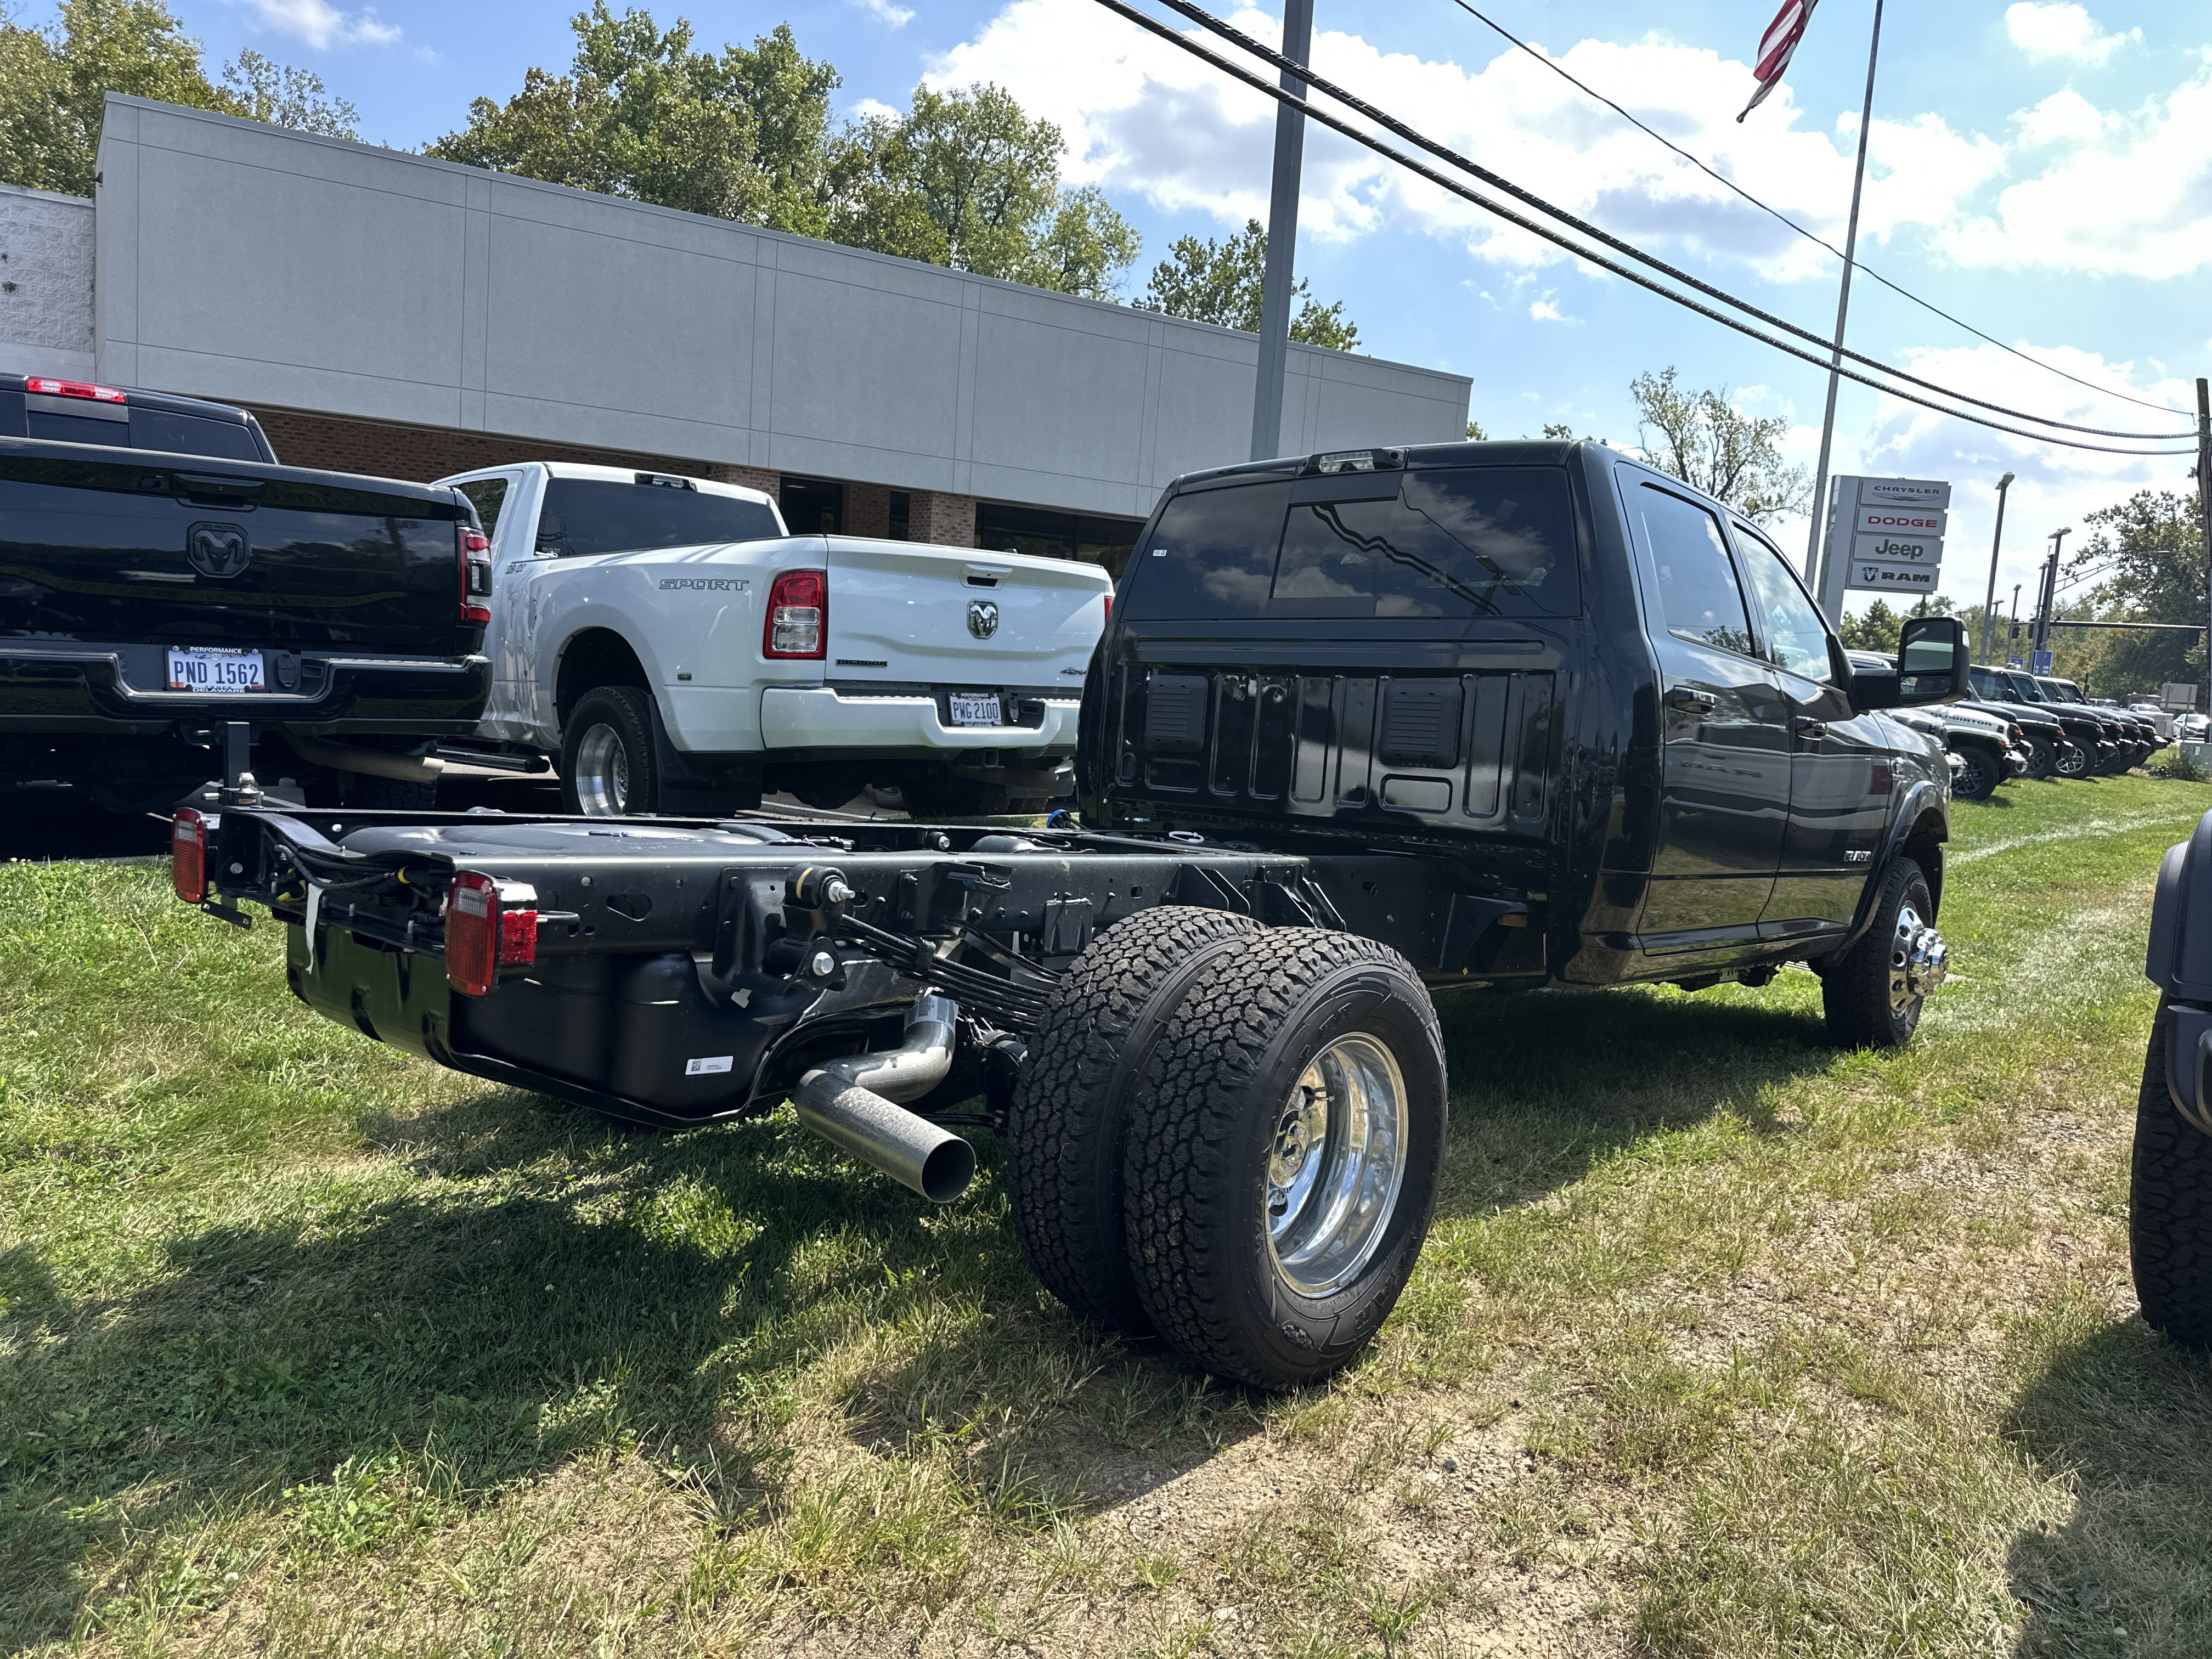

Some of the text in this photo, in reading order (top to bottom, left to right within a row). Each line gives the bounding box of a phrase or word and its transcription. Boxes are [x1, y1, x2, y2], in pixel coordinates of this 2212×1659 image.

[1874, 486, 1940, 494] CHRYSLER
[1867, 516, 1938, 528] DODGE
[1875, 539, 1924, 560] Jeep
[1881, 572, 1930, 583] RAM
[659, 579, 749, 591] SPORT
[190, 646, 242, 654] PERFORMANCE
[173, 661, 259, 685] PND 1562
[953, 702, 998, 719] PWG 2100
